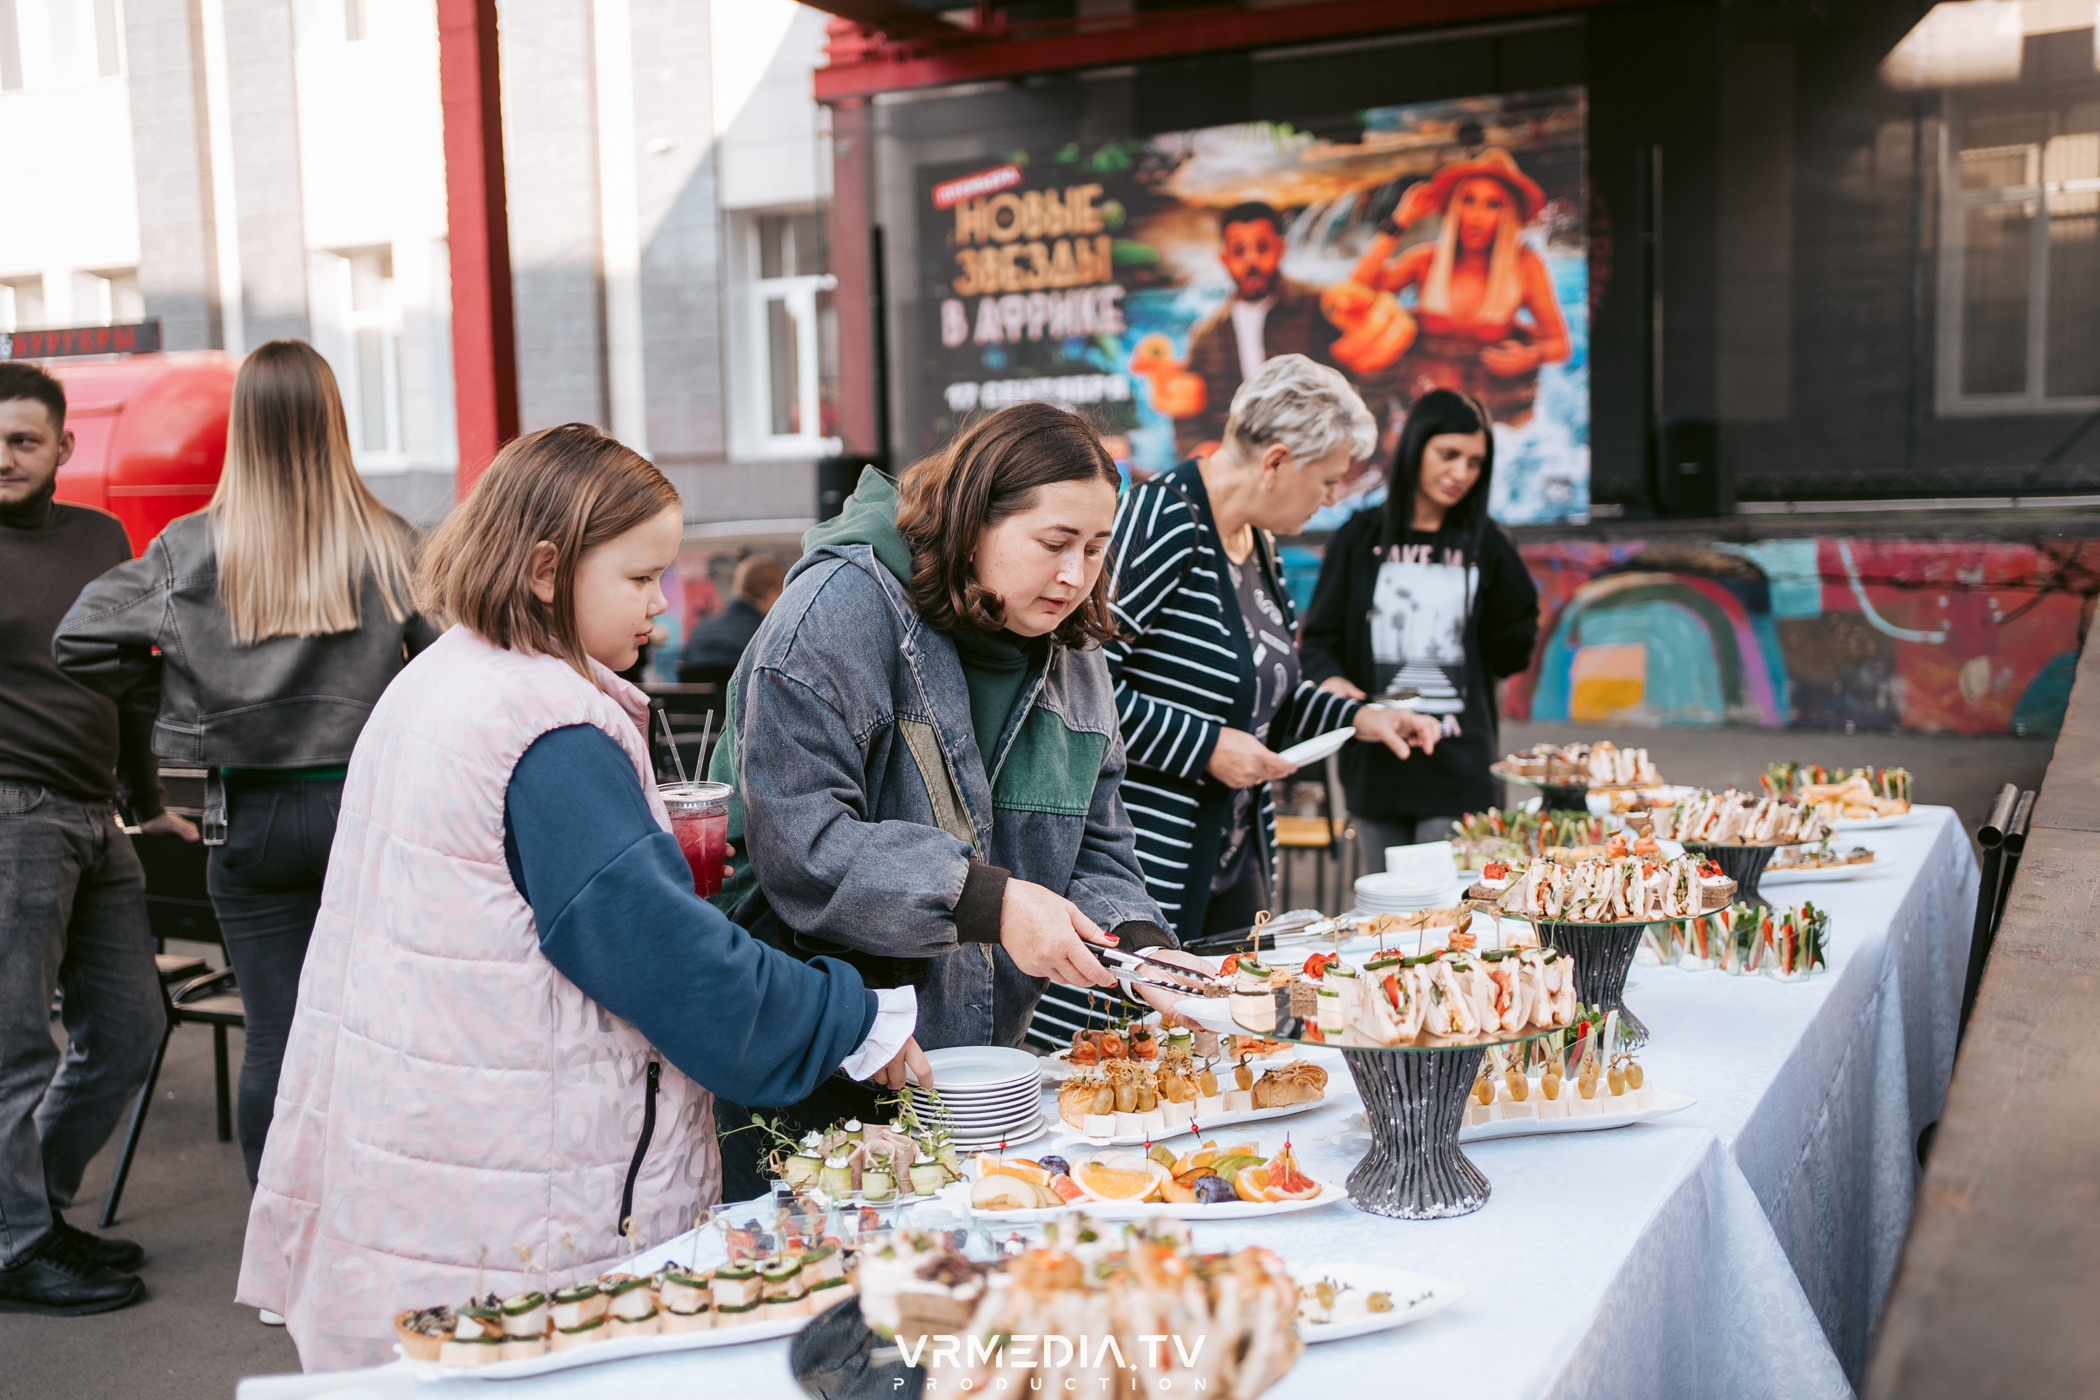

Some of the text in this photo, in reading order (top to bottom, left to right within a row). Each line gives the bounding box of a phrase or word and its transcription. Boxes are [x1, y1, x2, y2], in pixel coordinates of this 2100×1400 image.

[955, 183, 1104, 245] НОВЫЕ
[955, 235, 1113, 296] ЗВЕЗДЫ
[13, 326, 137, 358] БУРГЕРЫ
[941, 285, 1126, 347] В АФРИКЕ
